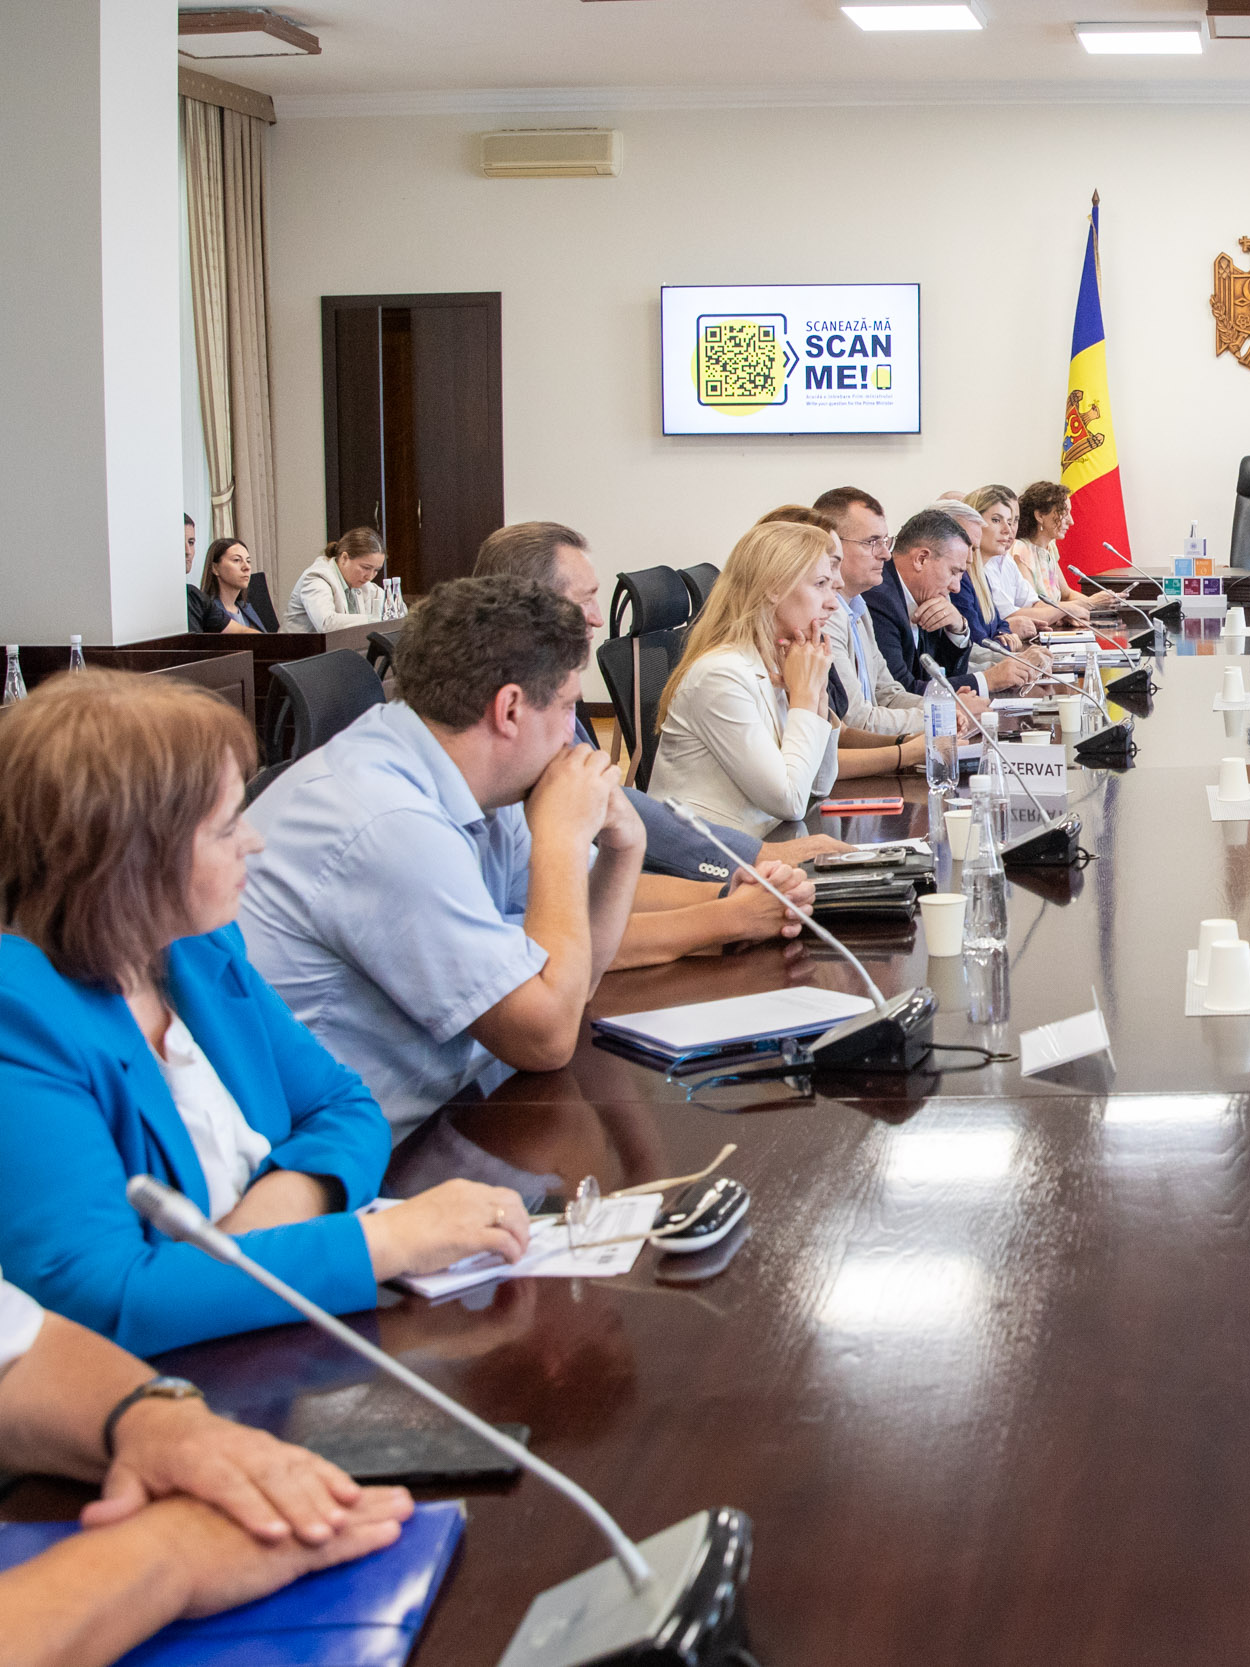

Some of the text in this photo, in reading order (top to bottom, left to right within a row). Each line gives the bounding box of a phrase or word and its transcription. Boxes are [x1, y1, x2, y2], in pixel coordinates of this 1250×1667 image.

[806, 317, 892, 332] SCANEAZĂ-MĂ
[805, 334, 892, 358] SCAN
[805, 365, 868, 390] ME!
